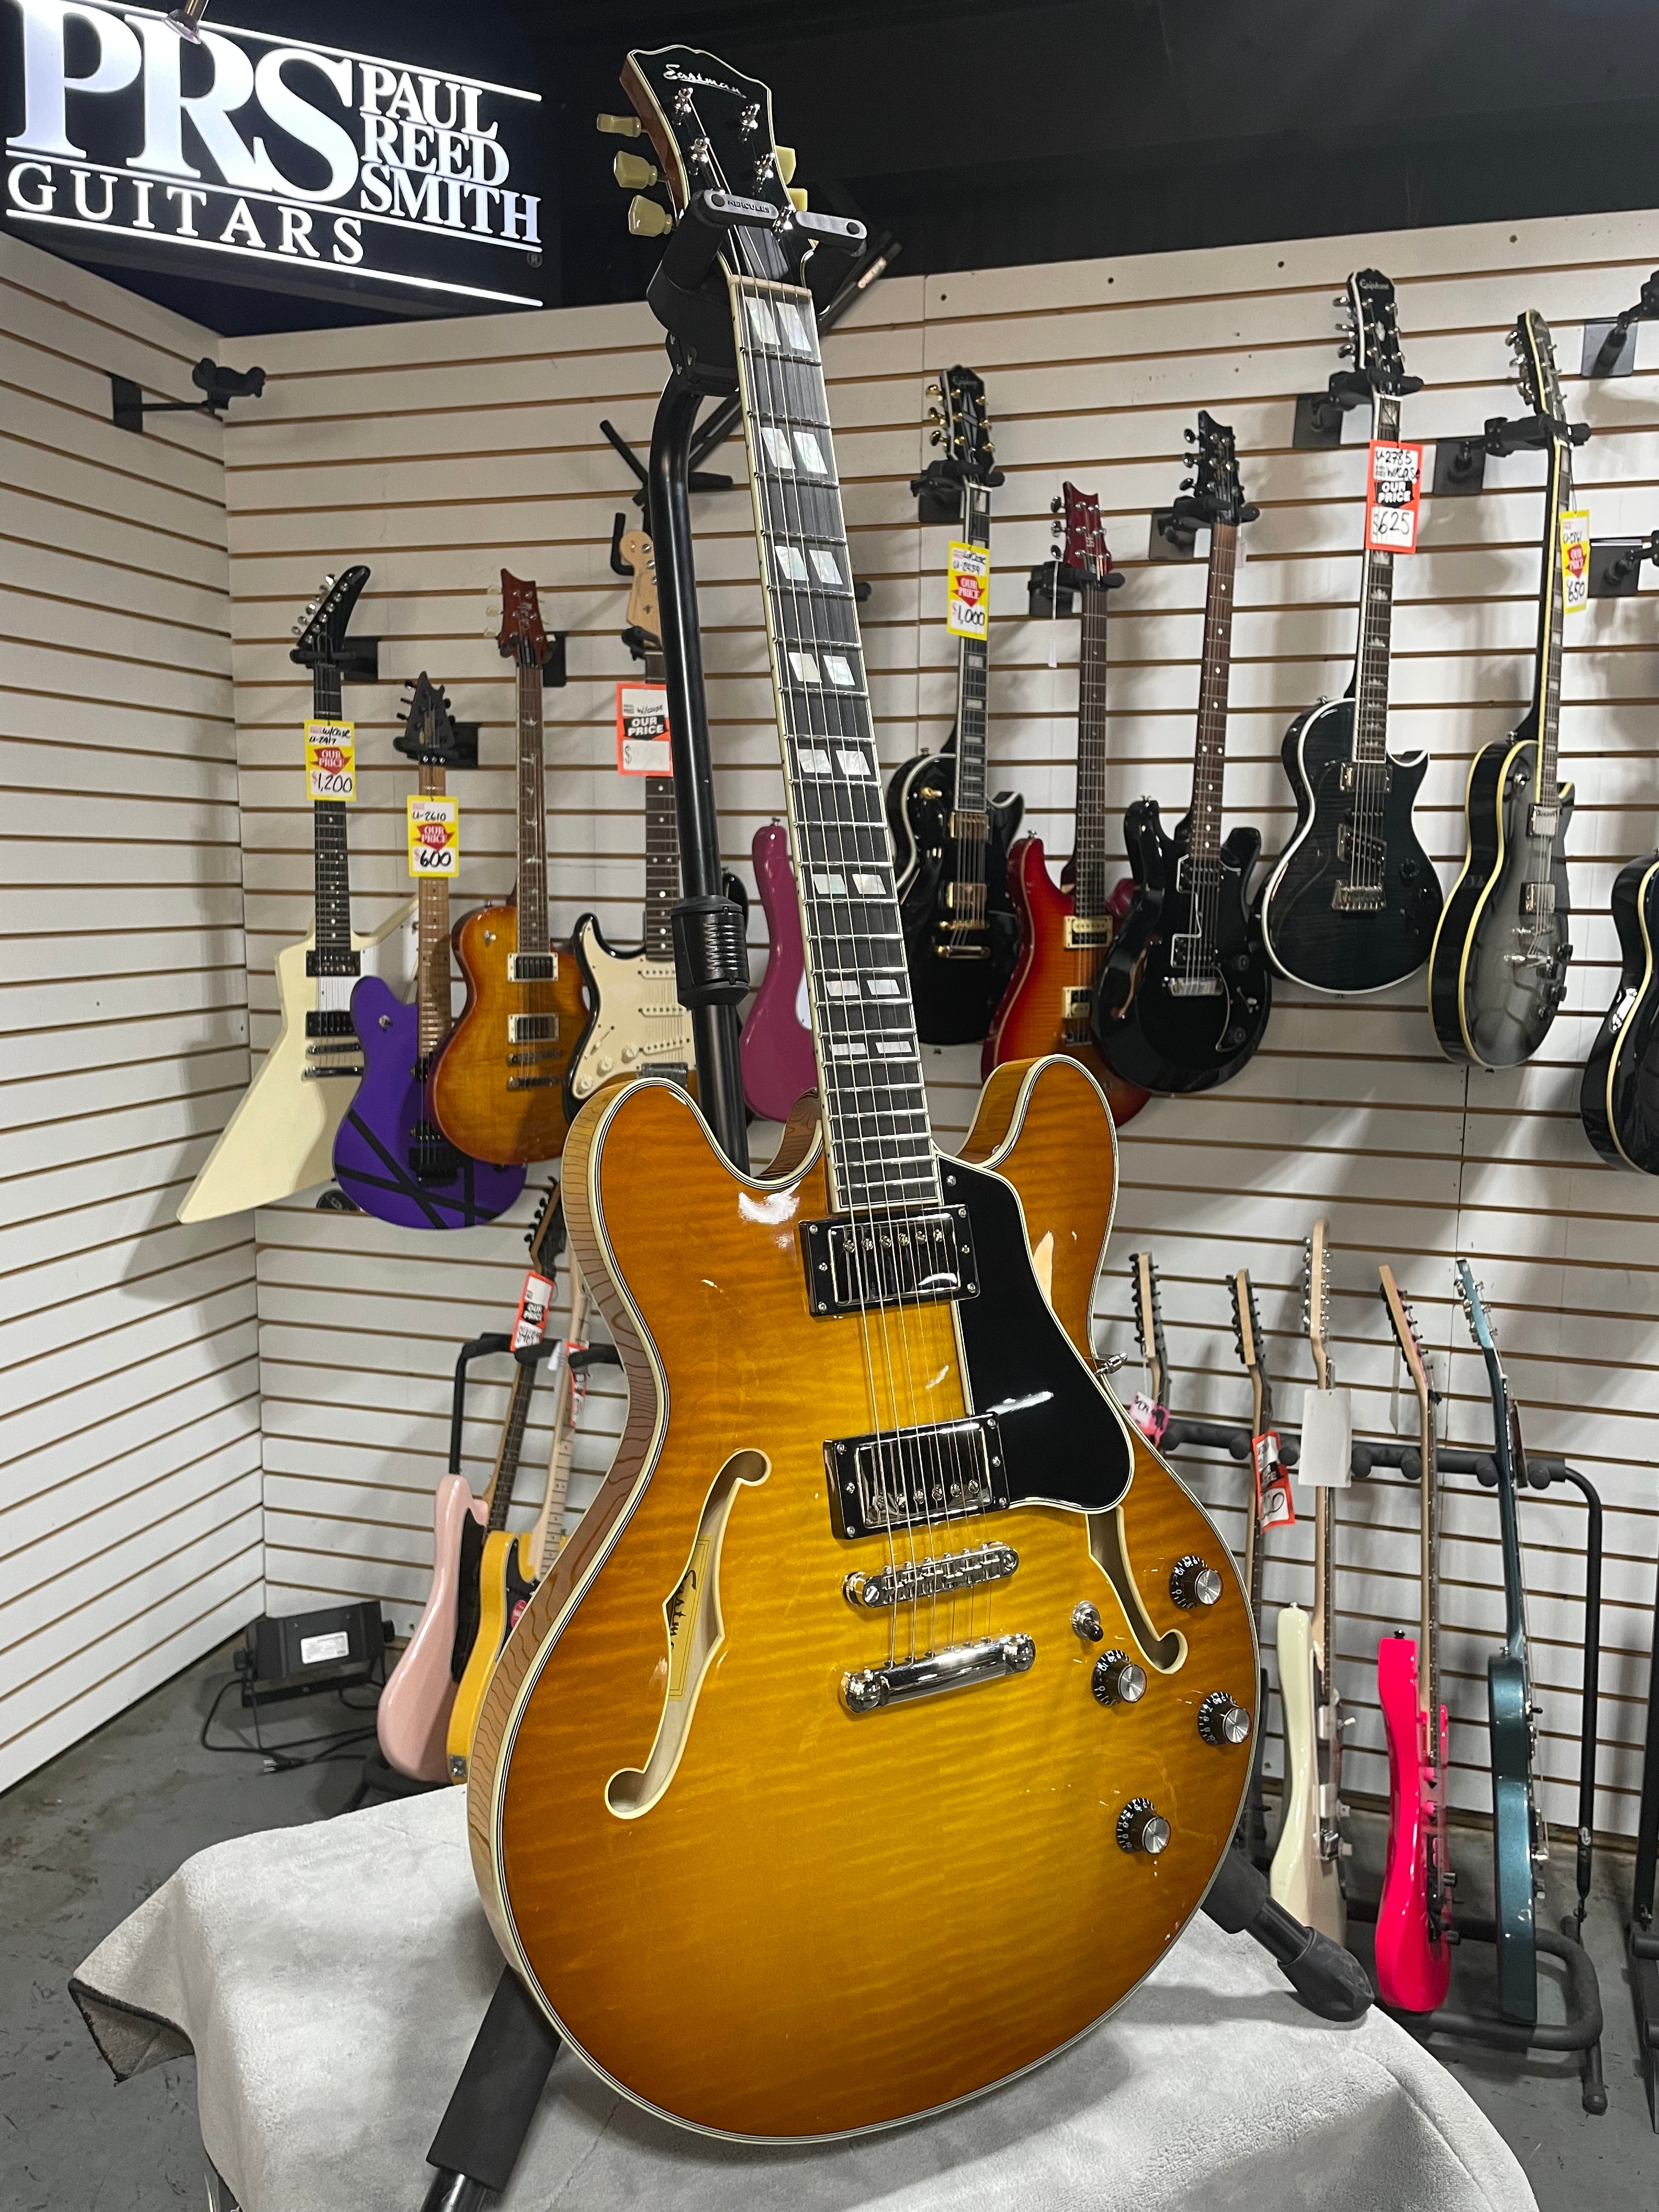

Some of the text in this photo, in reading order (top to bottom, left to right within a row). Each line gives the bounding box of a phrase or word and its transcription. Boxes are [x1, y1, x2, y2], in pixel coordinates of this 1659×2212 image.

[663, 64, 743, 95] Eastman
[7, 0, 359, 201] PRS
[358, 61, 499, 139] PAUL
[359, 111, 510, 187] REED
[359, 162, 542, 244] SMITH
[727, 200, 770, 213] HERCULES
[7, 162, 365, 265] GUITARS
[1381, 482, 1407, 493] OUR
[1378, 490, 1412, 503] PRICE
[1373, 511, 1410, 535] $625
[631, 716, 658, 727] OUR
[628, 725, 664, 736] PRICE
[321, 749, 341, 758] OUR
[319, 758, 345, 768] PRICE
[312, 771, 352, 793] $1,200
[421, 833, 447, 843] PRICE
[424, 826, 444, 834] OUR
[414, 848, 452, 867] $600
